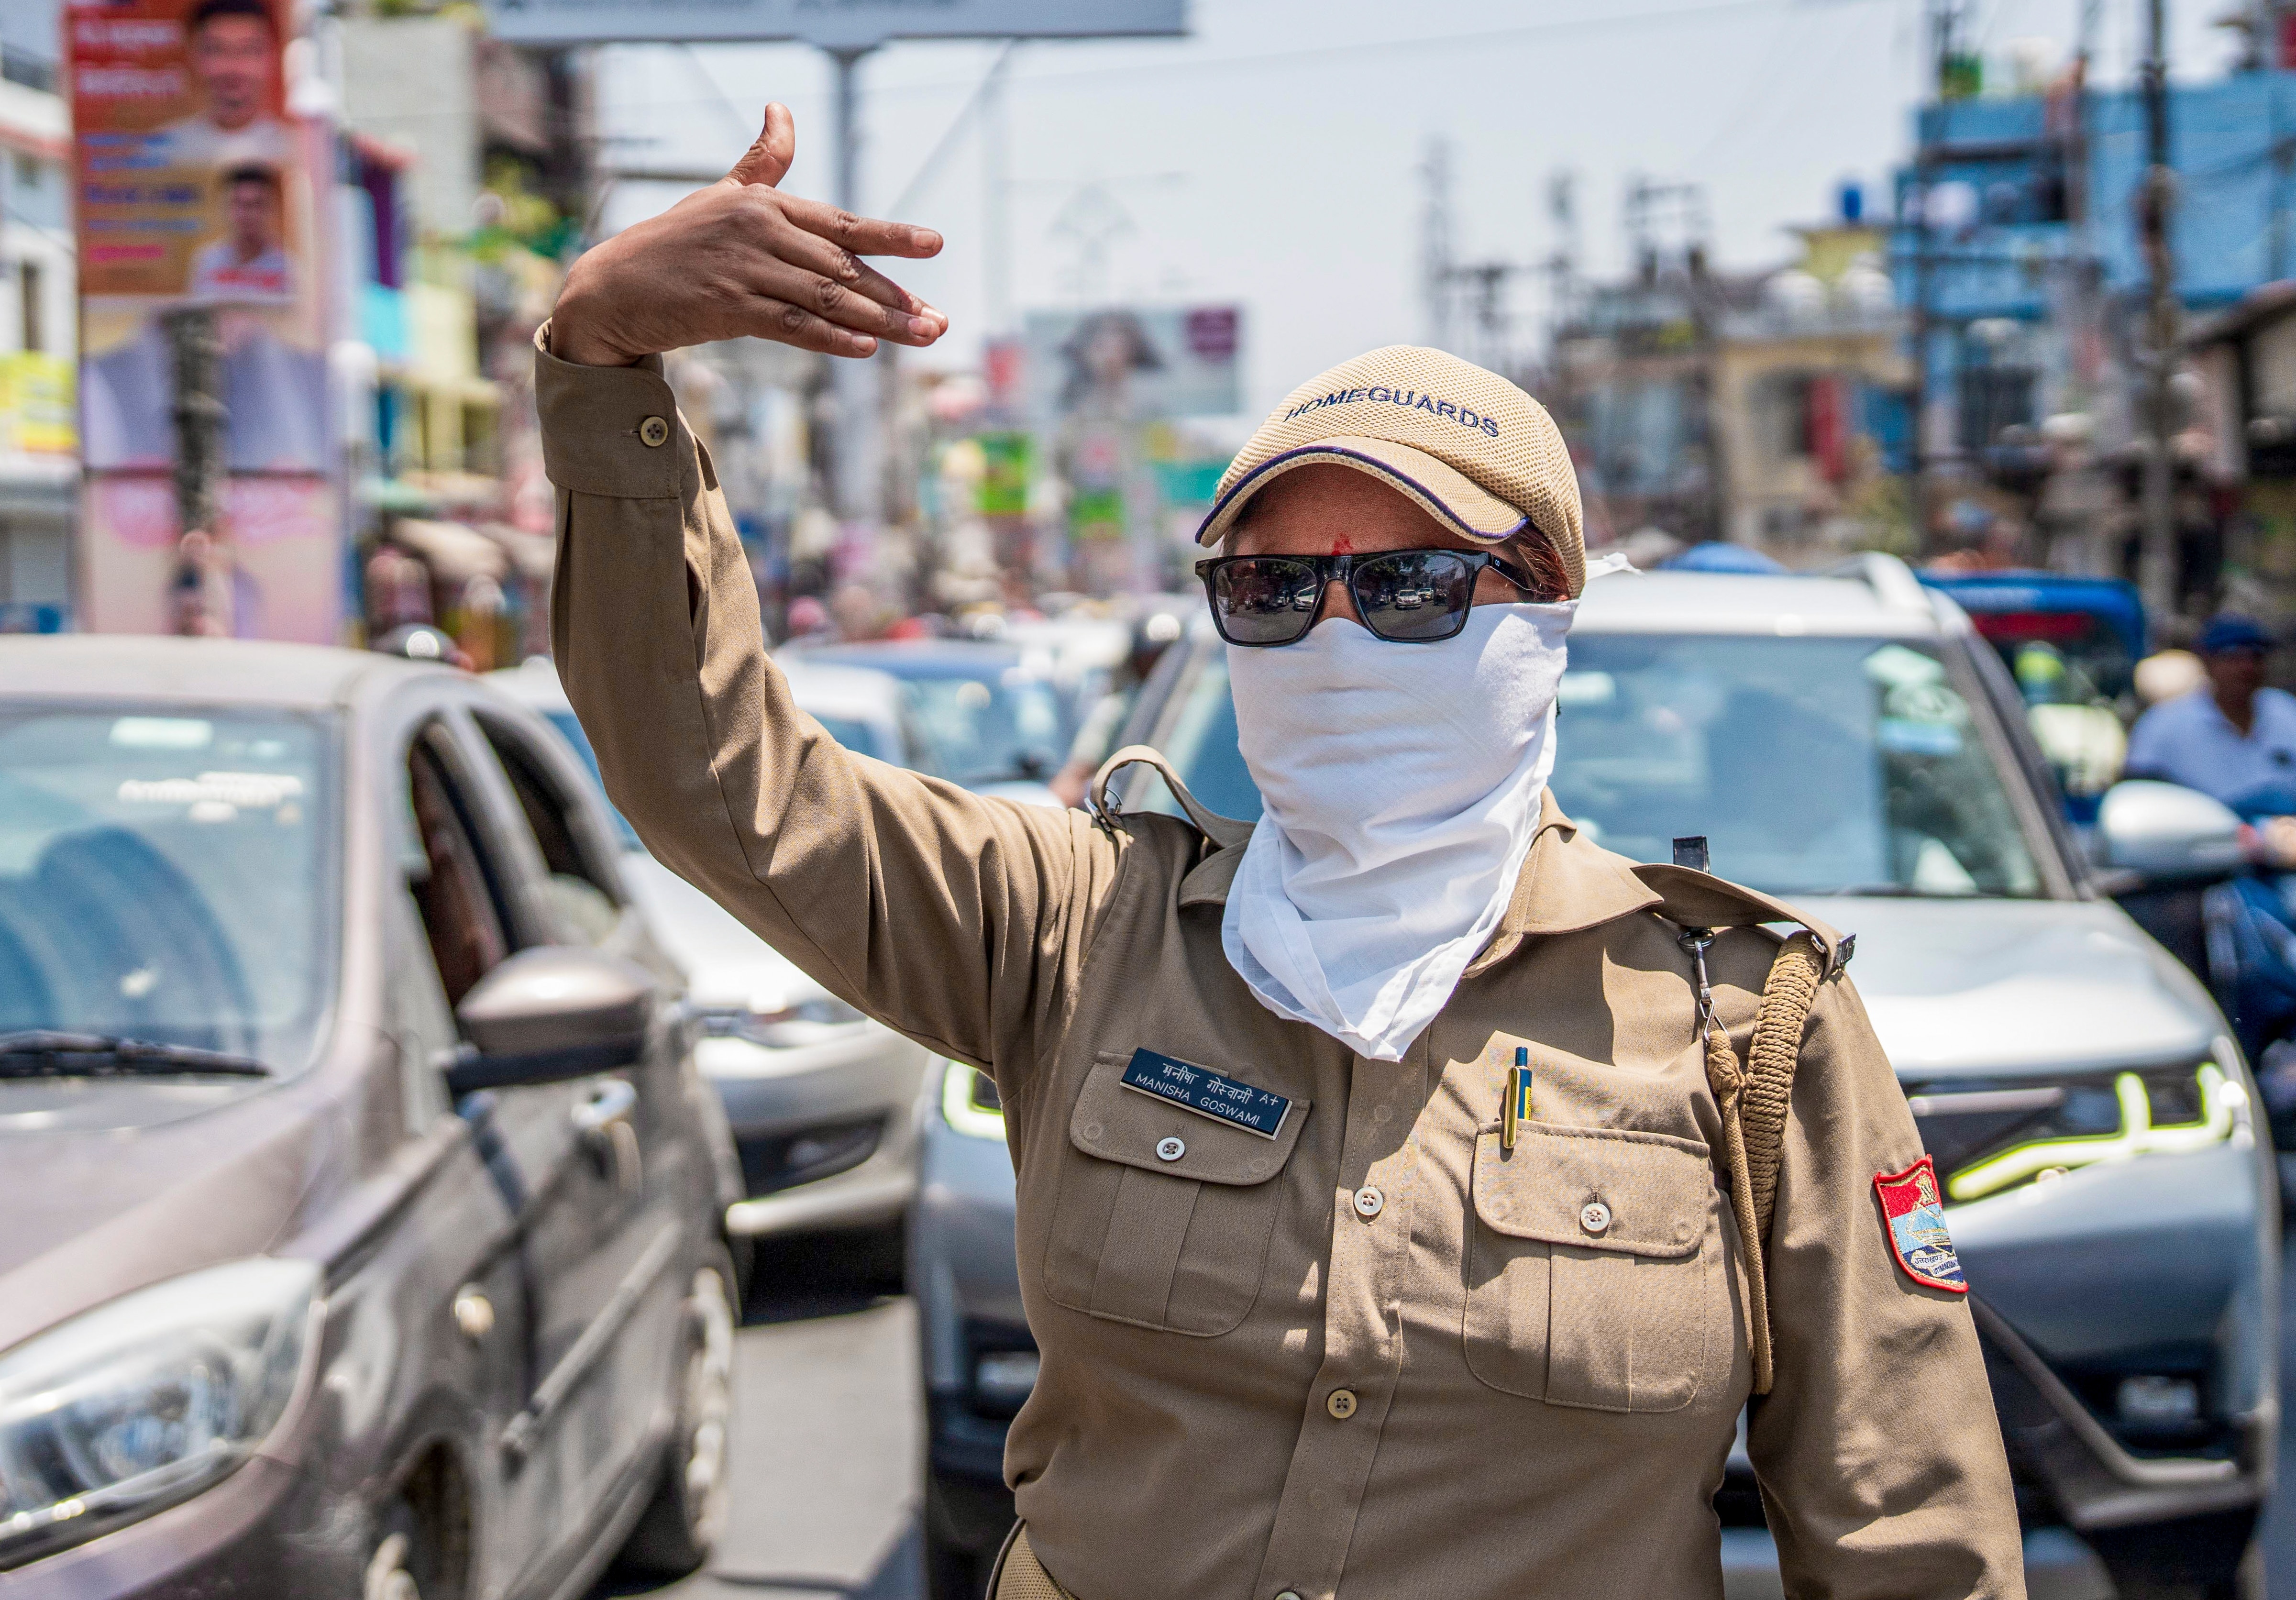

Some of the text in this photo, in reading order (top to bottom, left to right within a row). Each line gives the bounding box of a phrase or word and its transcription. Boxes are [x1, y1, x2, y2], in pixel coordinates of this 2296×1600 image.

[1284, 386, 1499, 438] HOMEGUARDS
[1135, 1073, 1260, 1125] MANISHA GOSWAMI
[1206, 1077, 1254, 1104] गोस्वामी
[1259, 1093, 1279, 1106] A+
